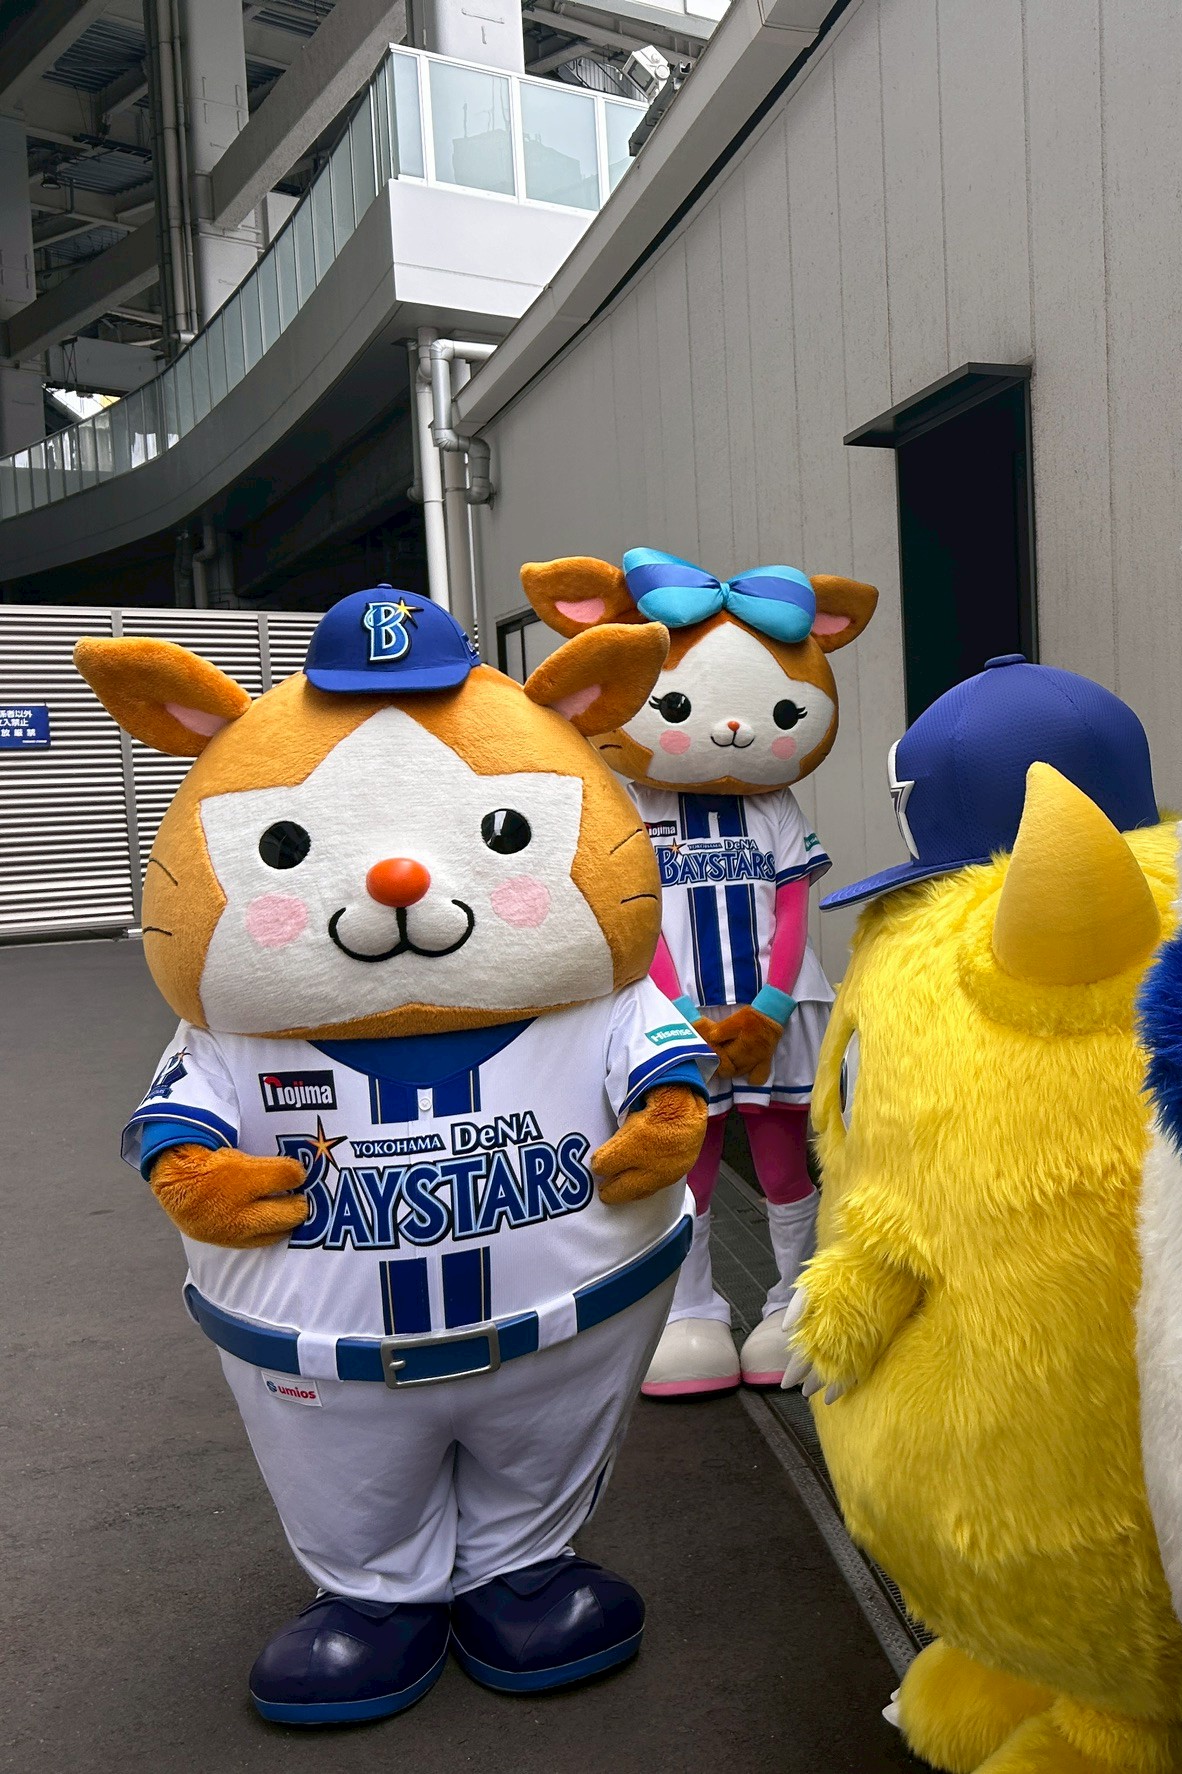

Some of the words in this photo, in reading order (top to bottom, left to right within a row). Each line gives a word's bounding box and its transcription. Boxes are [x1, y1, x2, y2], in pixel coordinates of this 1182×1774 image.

[362, 601, 411, 663] B
[724, 839, 758, 851] DeNA
[655, 846, 776, 887] BAYSTARS
[263, 1075, 333, 1108] nojima
[352, 1135, 443, 1156] YOKOHAMA
[452, 1112, 541, 1153] DeNA
[276, 1132, 594, 1250] BAYSTARS
